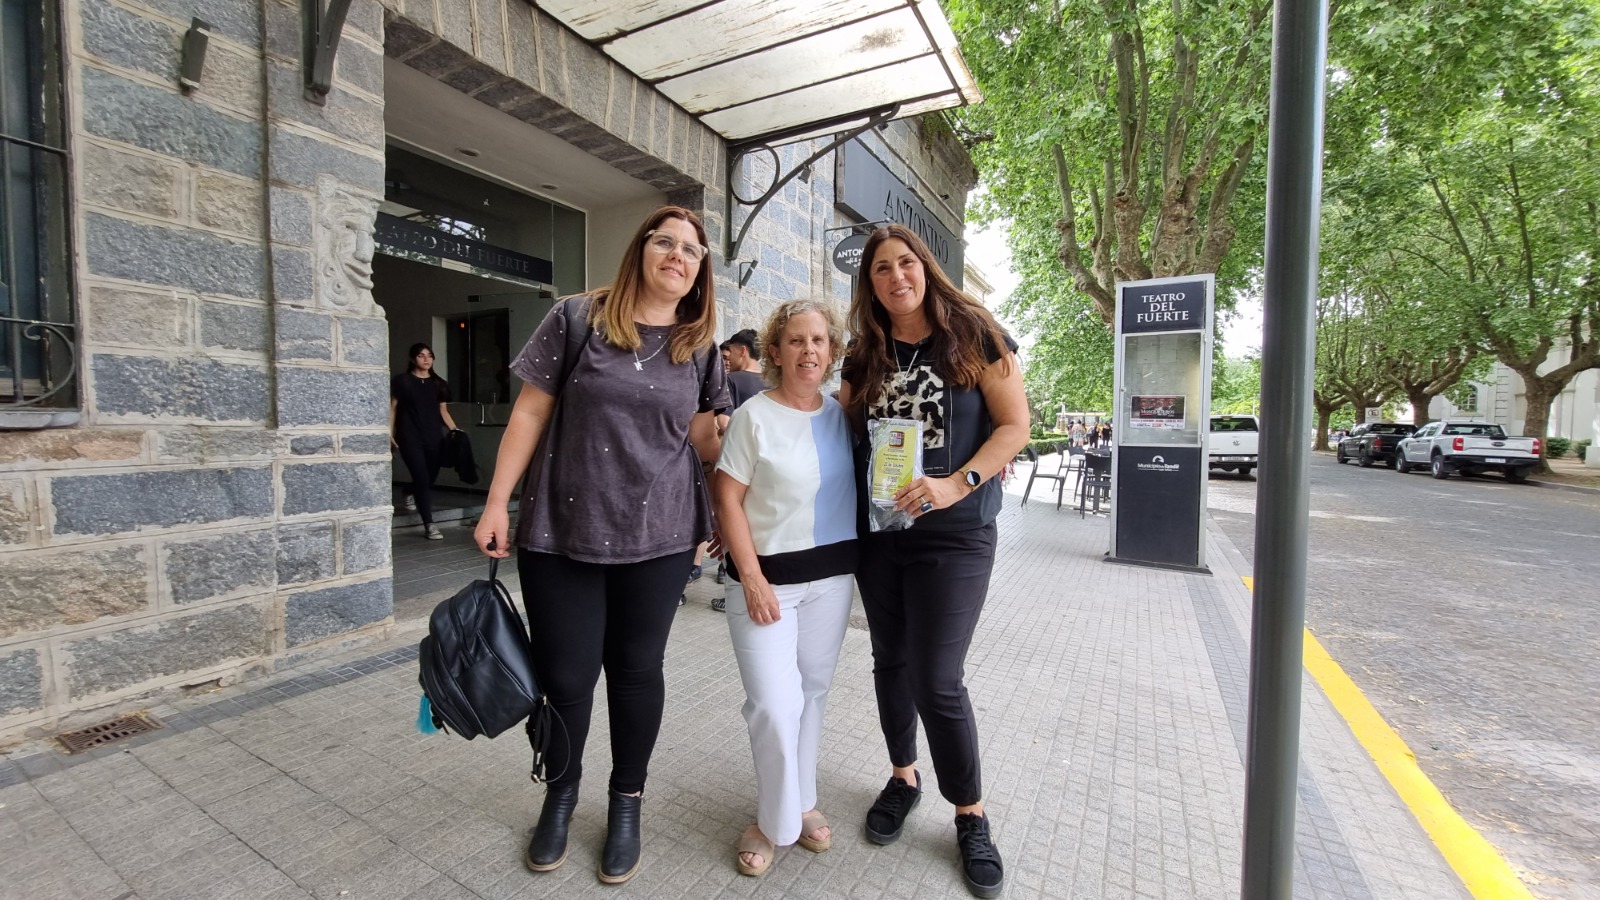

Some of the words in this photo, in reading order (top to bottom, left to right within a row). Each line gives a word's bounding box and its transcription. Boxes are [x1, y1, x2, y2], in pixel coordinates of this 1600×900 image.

[884, 189, 949, 264] ANTONINO
[477, 248, 530, 274] FUERTE
[1141, 292, 1186, 303] TEATRO
[1150, 302, 1176, 312] DEL
[1137, 310, 1190, 323] FUERTE
